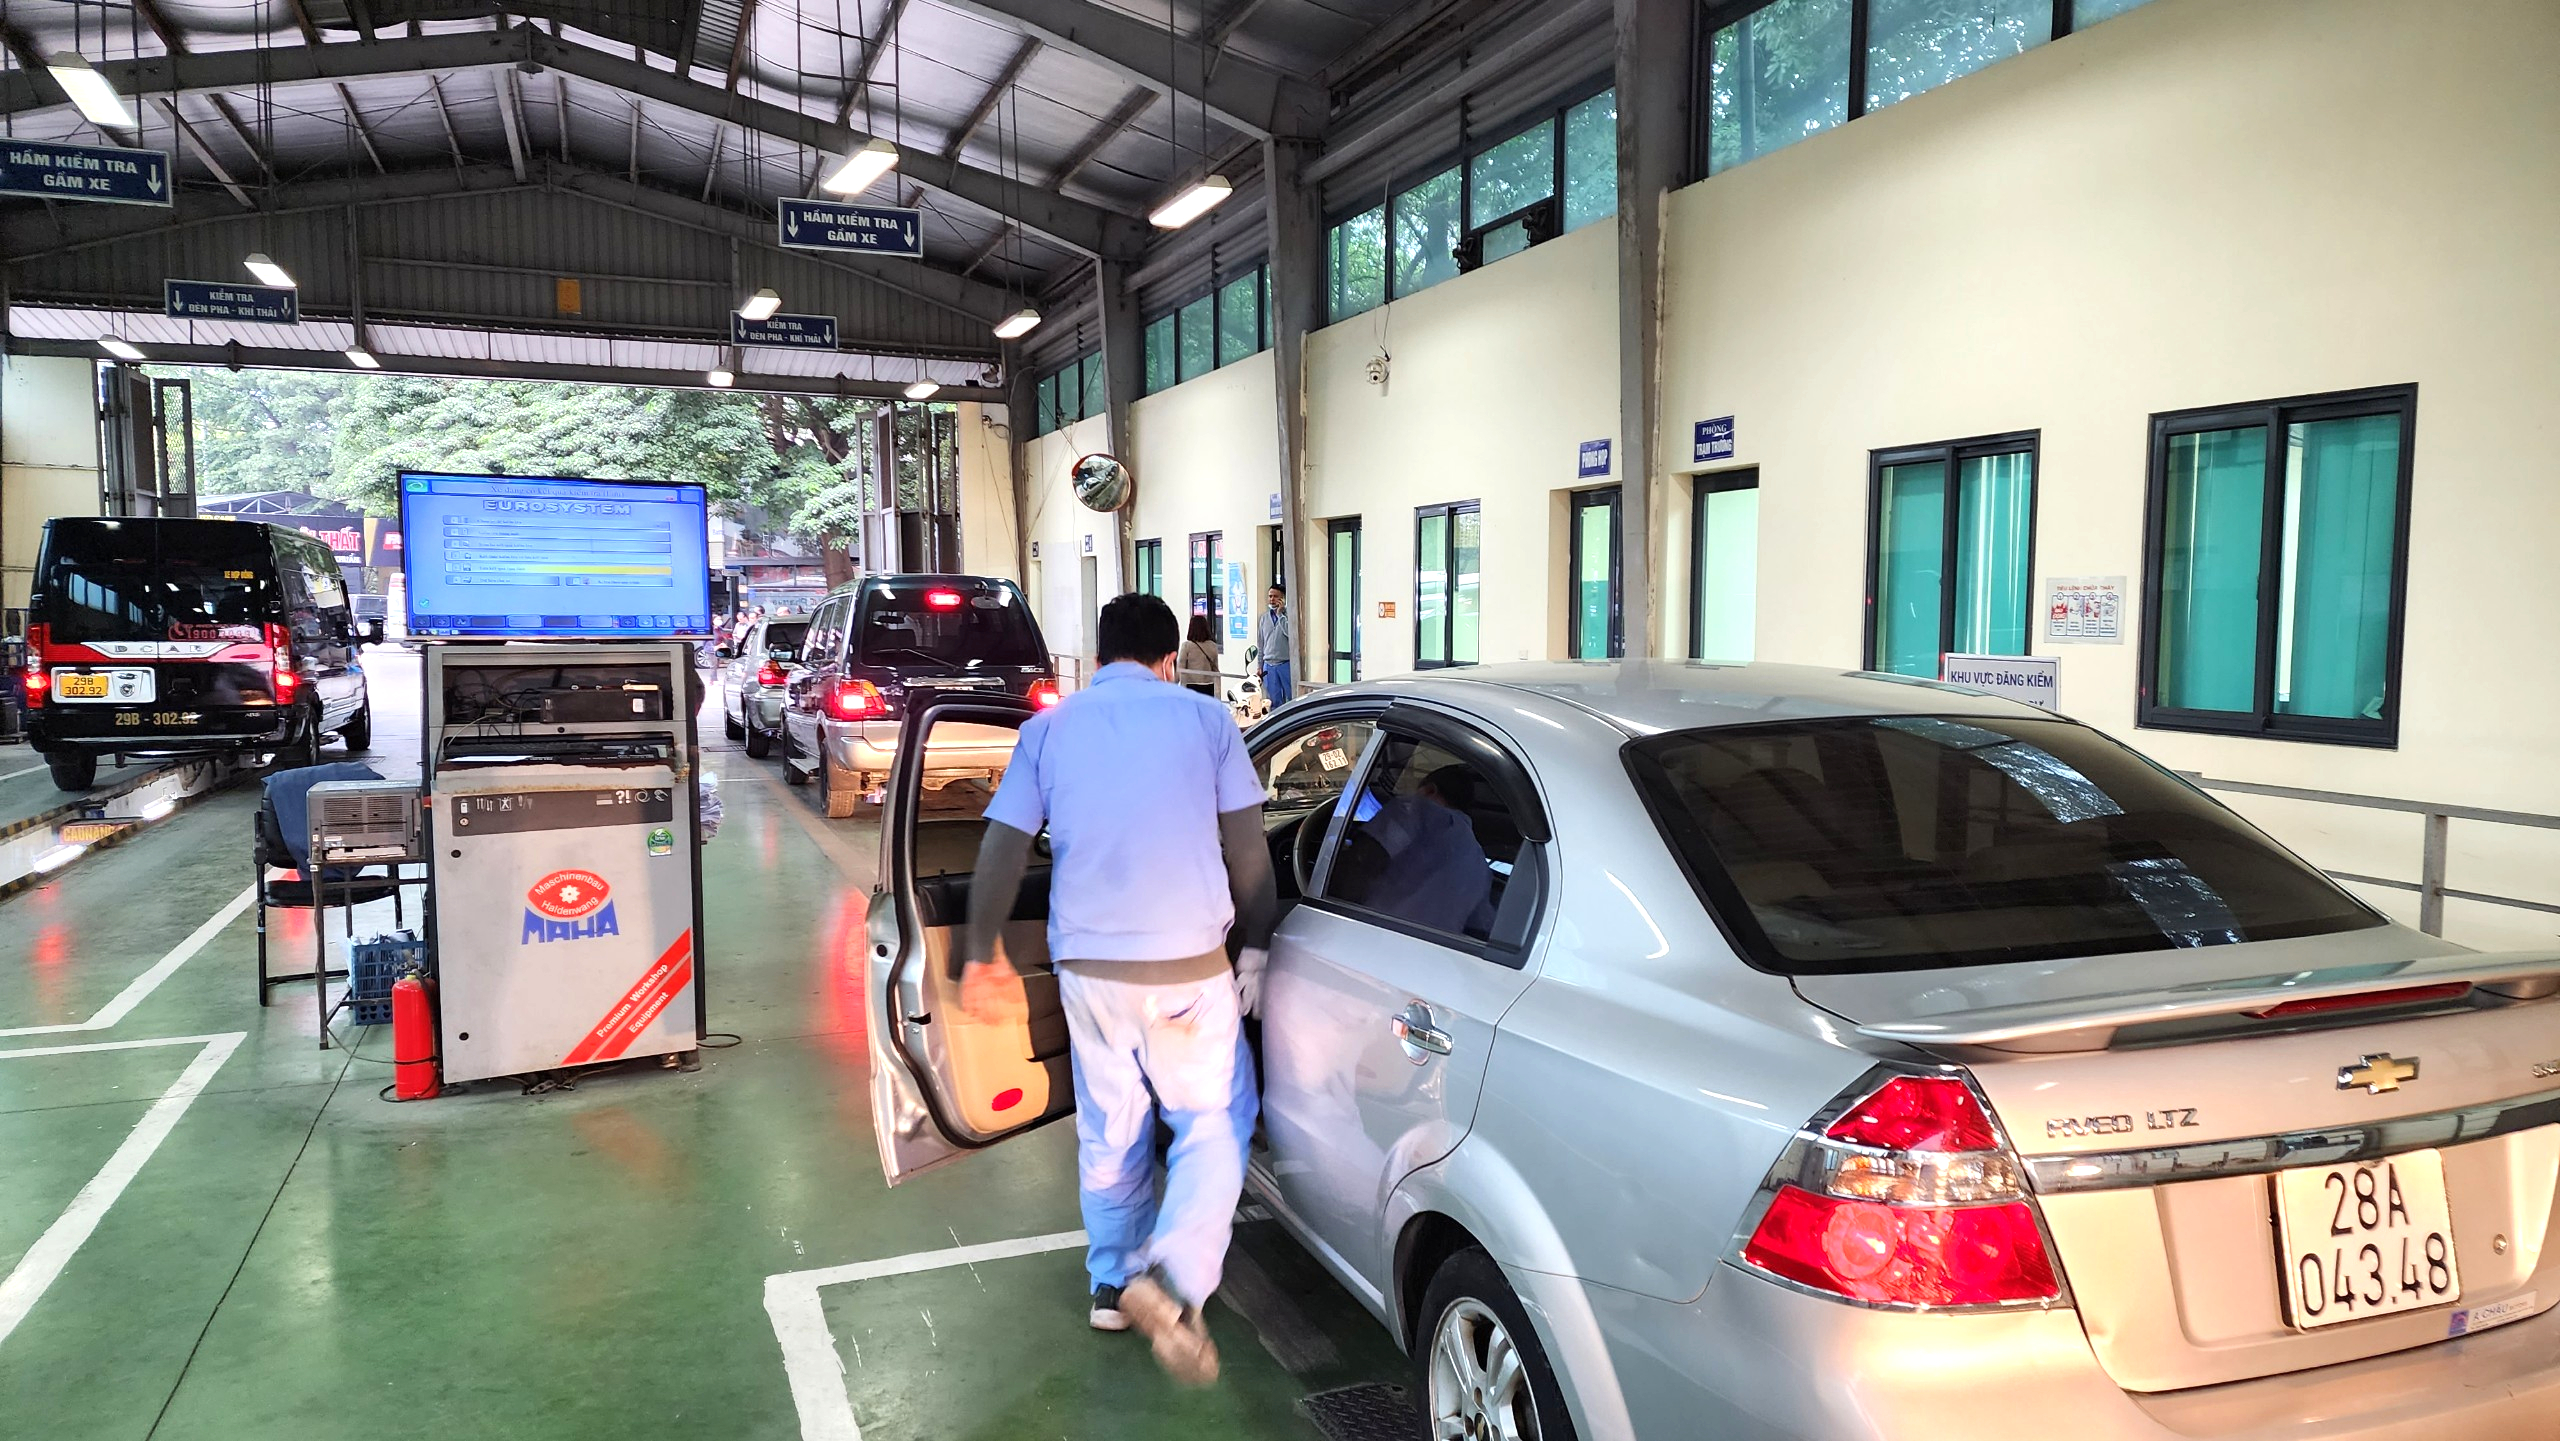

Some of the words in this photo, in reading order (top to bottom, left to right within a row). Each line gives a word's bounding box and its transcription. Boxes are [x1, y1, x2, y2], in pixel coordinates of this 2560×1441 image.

[55, 152, 99, 170] KIỂM
[104, 159, 138, 174] TRA
[88, 177, 111, 191] XE
[837, 211, 870, 228] KIỂM
[873, 217, 899, 230] TRA
[860, 232, 878, 245] XE
[209, 288, 234, 302] KIỂM
[236, 293, 255, 303] TRA
[188, 301, 208, 313] ĐÈN
[210, 304, 230, 315] PHA
[238, 305, 254, 316] KHÍ
[766, 317, 787, 329] KIỂM
[788, 322, 803, 331] TRA
[767, 332, 783, 341] PHA
[1702, 423, 1727, 436] PHÒNG
[483, 500, 632, 515] EUROSYSTEM
[319, 525, 361, 552] THẤT
[73, 677, 94, 686] 29B
[1951, 671, 1971, 683] KHU
[1974, 672, 1994, 687] VỰC
[1996, 671, 2025, 686] ĐĂNG
[2027, 670, 2053, 688] KIỂM
[65, 686, 102, 695] 302.92
[115, 712, 140, 726] 29B
[534, 872, 604, 895] Maschinenbau
[541, 896, 598, 916] Haldenwang
[521, 898, 619, 945] MAHA
[596, 1003, 631, 1037] Premium
[629, 964, 668, 1002] Workshop
[628, 991, 669, 1033] Equipment
[2046, 1114, 2133, 1138] AVEO
[2146, 1107, 2200, 1130] LTZ
[2325, 1163, 2410, 1237] 28A
[2300, 1232, 2449, 1316] 043.48
